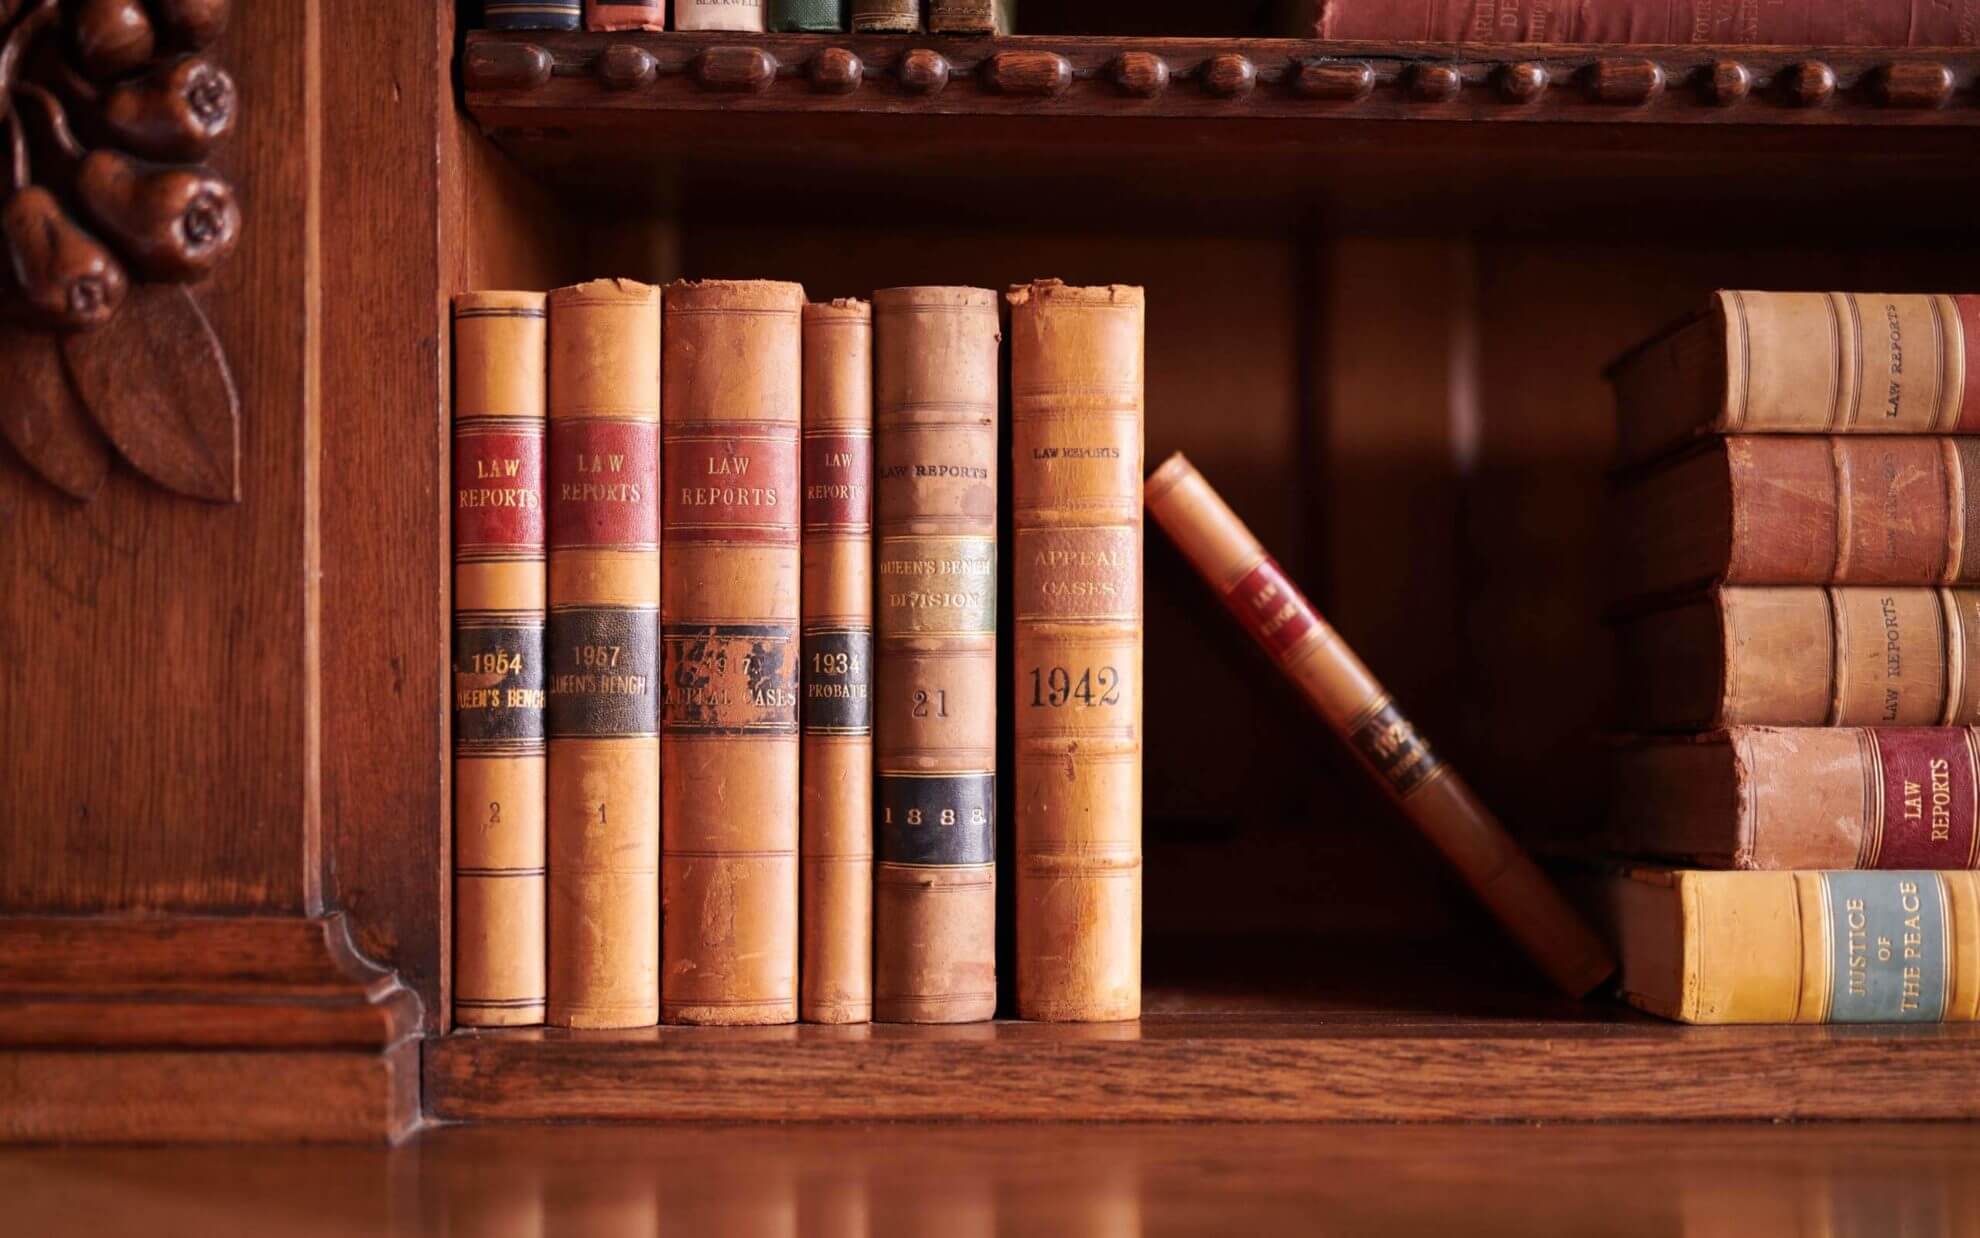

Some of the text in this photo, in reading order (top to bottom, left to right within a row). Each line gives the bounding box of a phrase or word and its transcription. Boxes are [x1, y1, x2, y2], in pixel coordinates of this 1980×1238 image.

[1886, 304, 1902, 418] LAW REPORTS
[578, 454, 624, 473] LAW
[824, 453, 855, 468] LAW
[1033, 448, 1120, 459] LAW REPORTS
[477, 459, 520, 479] LAW
[708, 457, 750, 475] LAW
[914, 465, 988, 479] REPORTS
[459, 488, 539, 508] REPORTS
[562, 483, 641, 502] REPORTS
[681, 487, 777, 506] REPORTS
[808, 485, 865, 499] REPORTS
[940, 560, 990, 575] BENCH
[1035, 550, 1125, 566] APPEAL
[1042, 581, 1117, 596] CASES
[889, 592, 981, 608] DIVISION
[812, 652, 860, 674] 1934
[1882, 597, 1900, 721] LAW REPORTS
[809, 684, 868, 698] PROBATE
[1030, 666, 1120, 708] 1942
[912, 689, 949, 719] 21
[1904, 780, 1922, 819] LAW
[1931, 759, 1949, 841] REPORTS
[489, 802, 501, 823] 2
[598, 803, 608, 824] 1
[1847, 898, 1867, 996] JUSTICE
[1878, 936, 1892, 961] OF
[1900, 880, 1921, 1012] THE PEACE
